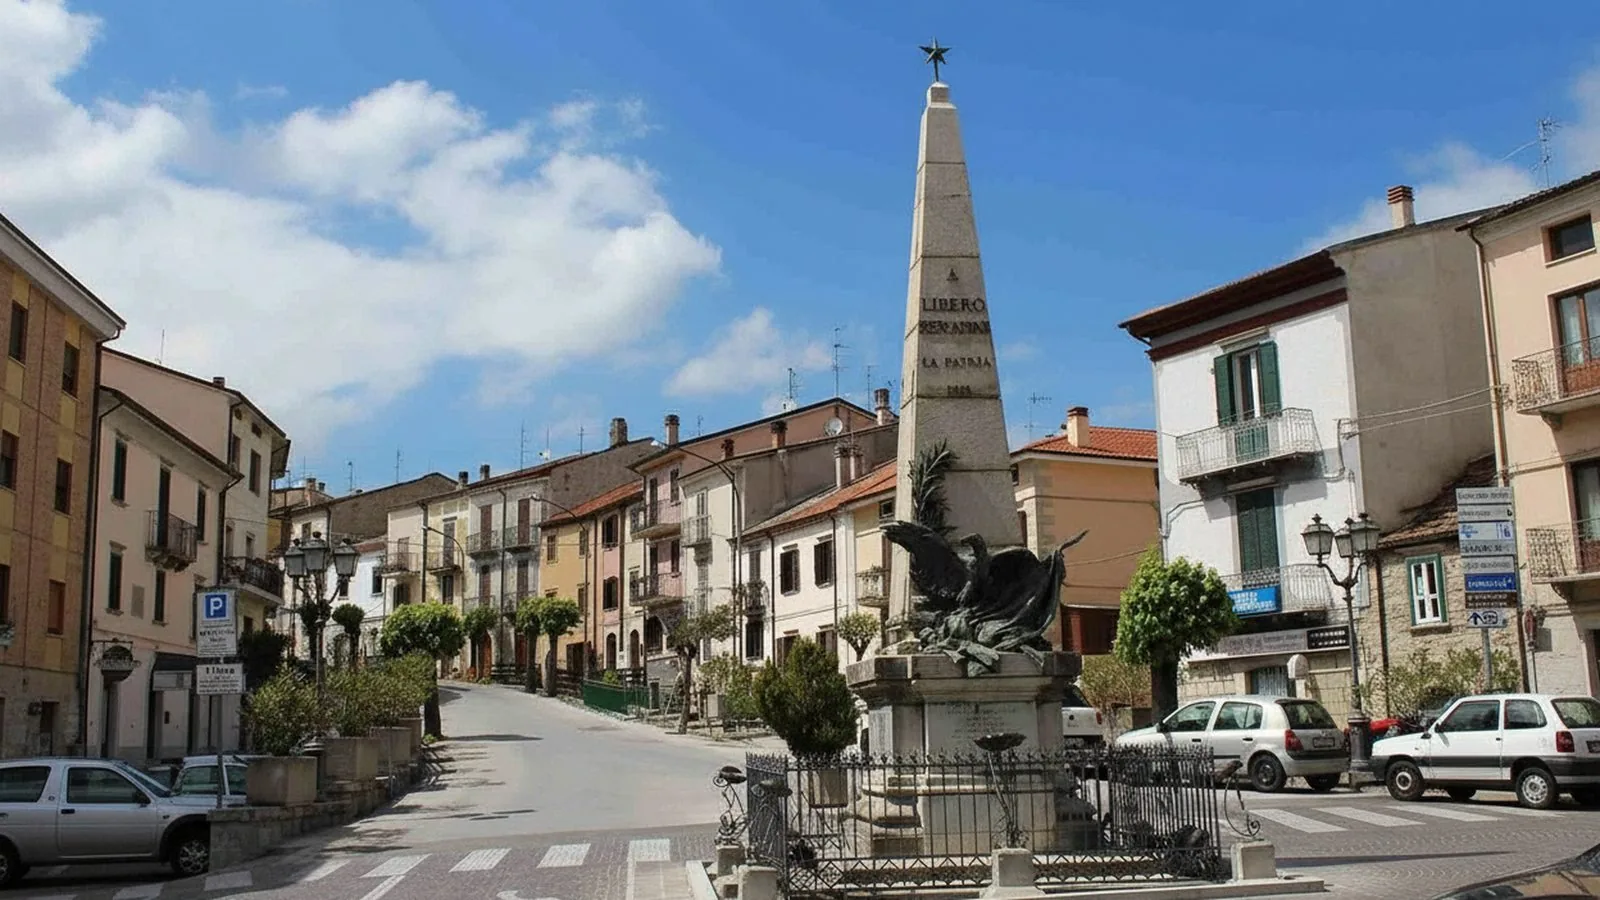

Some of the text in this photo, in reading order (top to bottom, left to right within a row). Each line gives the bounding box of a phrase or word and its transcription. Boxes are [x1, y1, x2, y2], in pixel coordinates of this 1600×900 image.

[946, 268, 959, 281] A
[922, 298, 985, 313] LIBERO
[922, 357, 938, 369] LA
[945, 357, 992, 369] PATRIA
[210, 596, 222, 616] P
